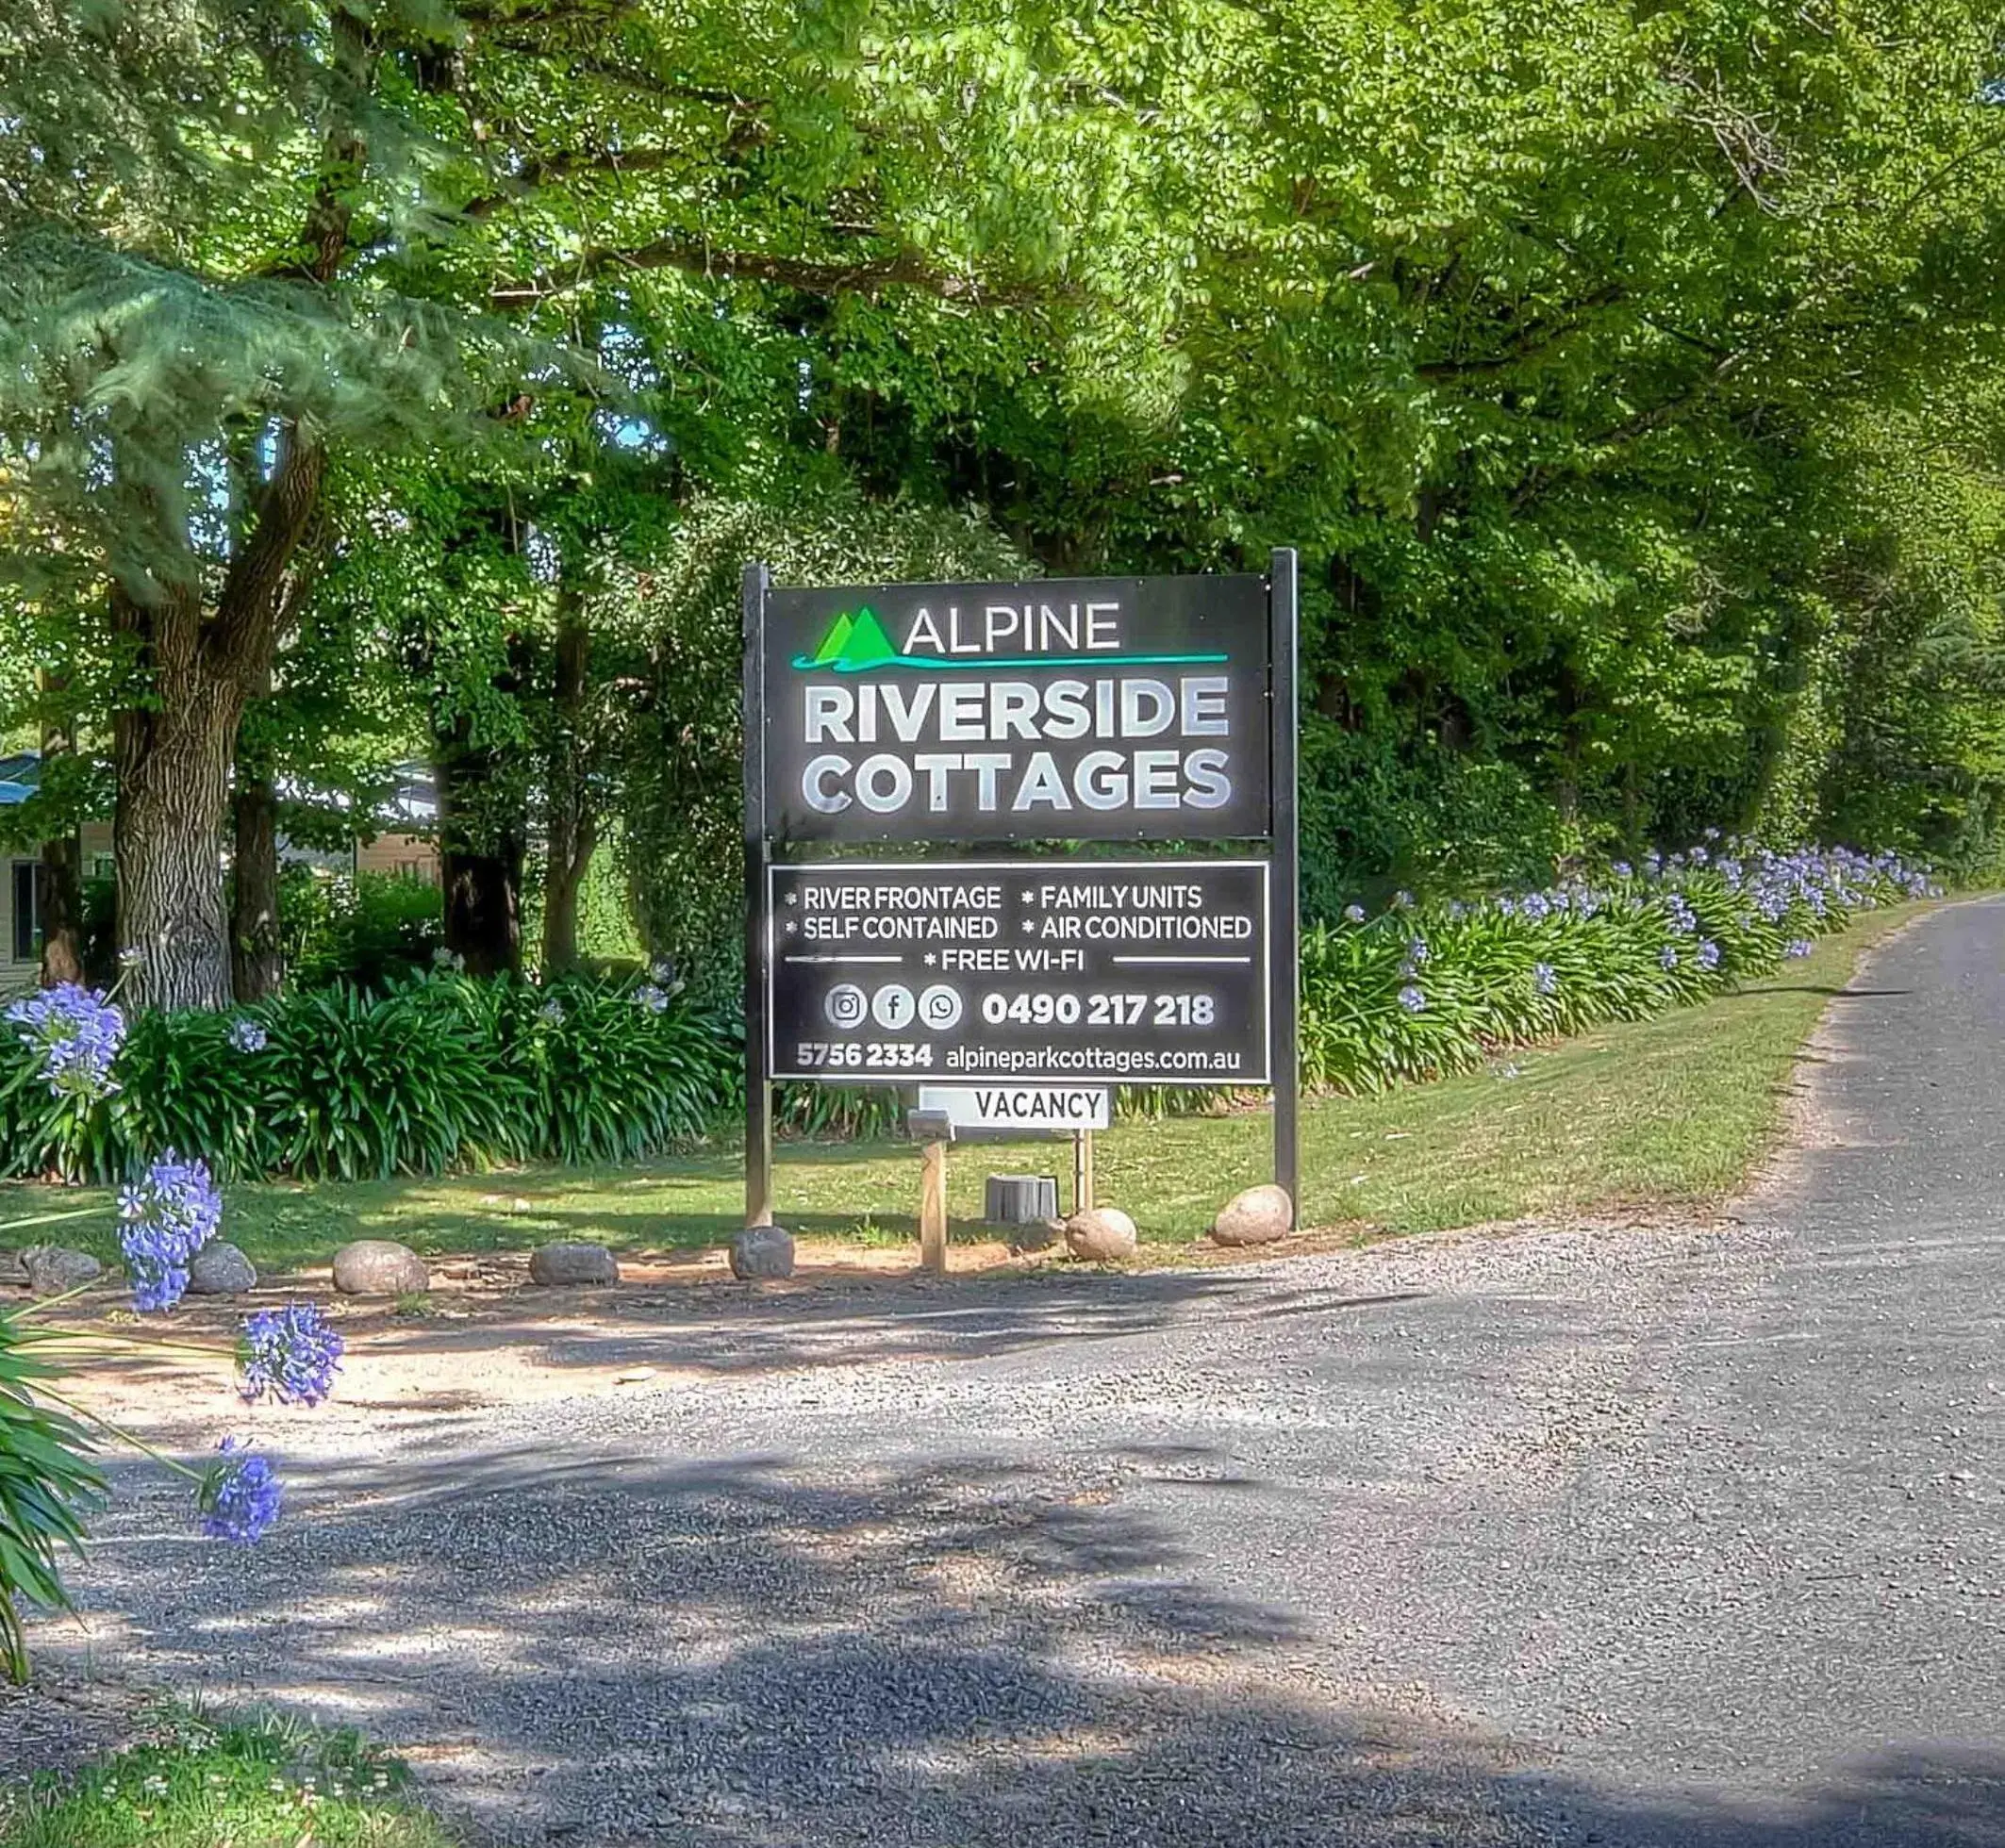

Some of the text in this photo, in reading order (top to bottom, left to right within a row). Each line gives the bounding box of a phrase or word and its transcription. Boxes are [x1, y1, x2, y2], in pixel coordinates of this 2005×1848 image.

[903, 602, 1121, 654] ALPINE
[804, 676, 1230, 743] RIVERSIDE
[802, 748, 1232, 813] COTTAGES
[804, 886, 1002, 910] RIVER FRONTAGE
[1041, 885, 1202, 908] FAMILY UNITS
[804, 916, 998, 939] SELF CONTAINED
[1041, 916, 1251, 939] AIR CONDITIONED
[942, 949, 1084, 971] FREE WI-FI
[982, 993, 1216, 1025] 0490 217 218
[797, 1043, 934, 1067] 5756 2334
[946, 1046, 1241, 1072] alpineparkcottages.com.au
[975, 1091, 1102, 1119] VACANCY
